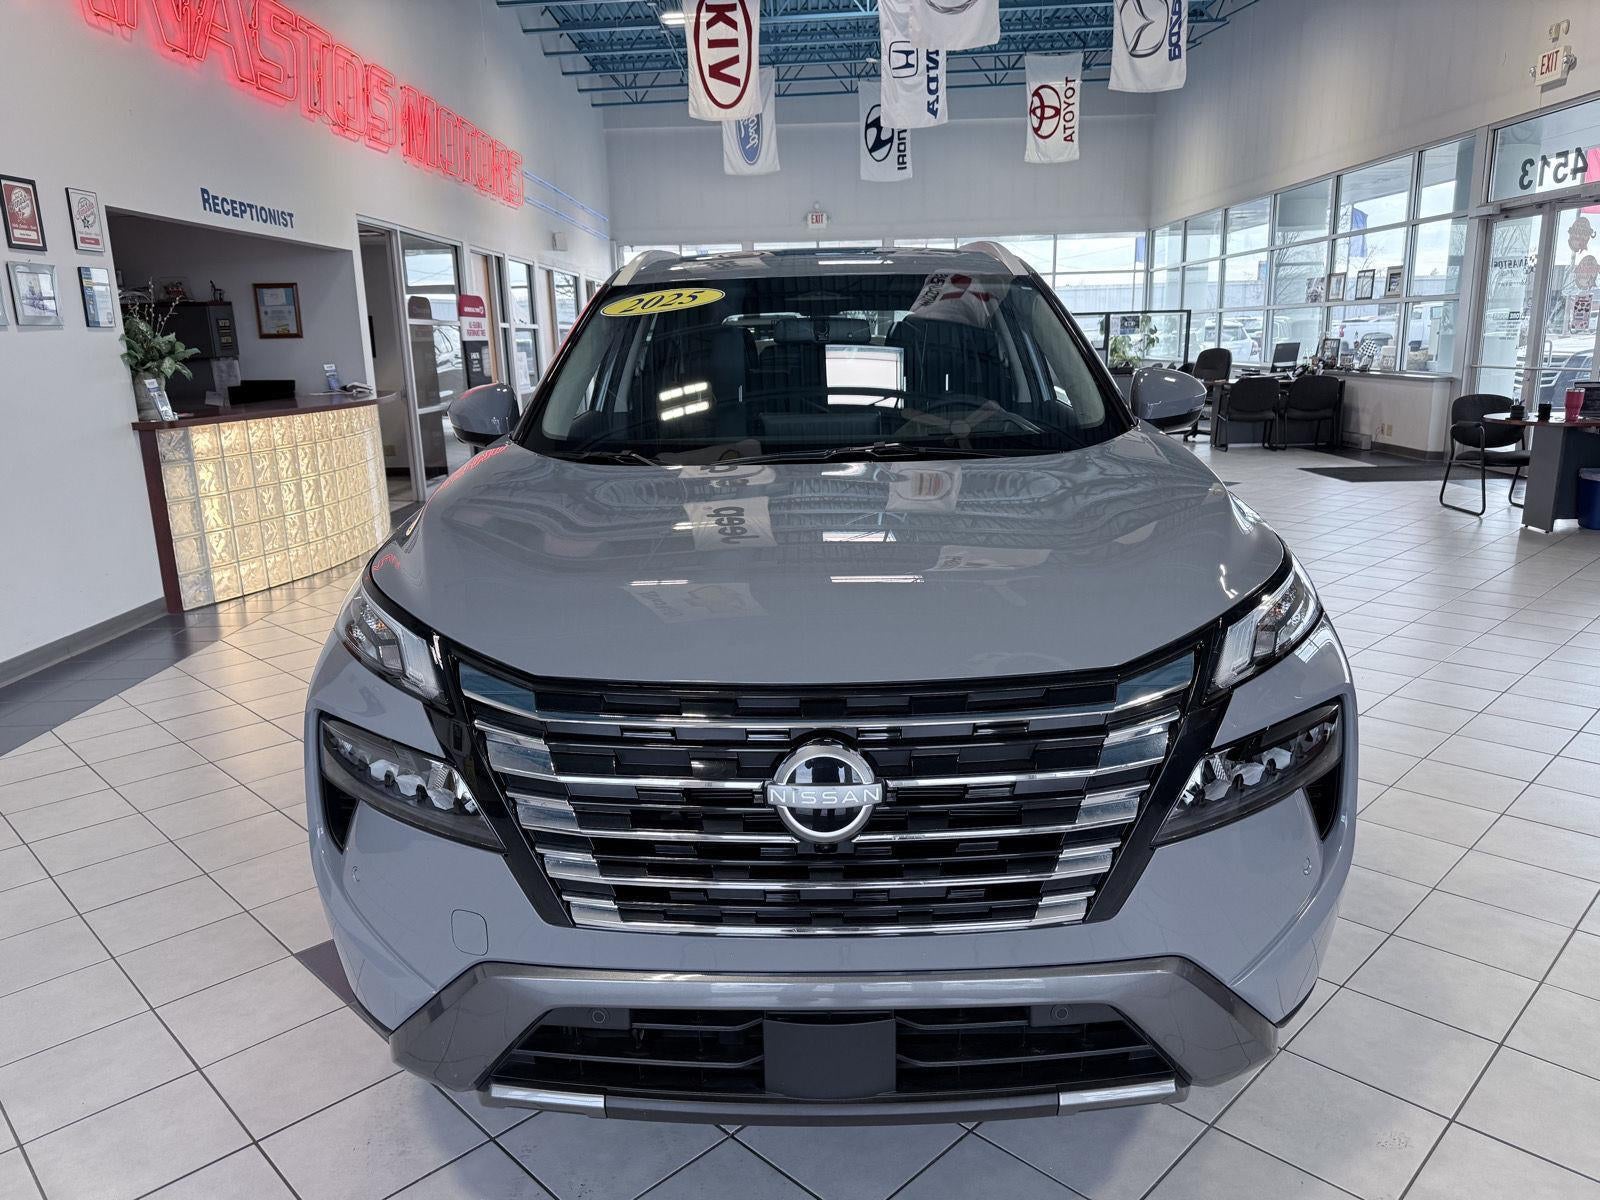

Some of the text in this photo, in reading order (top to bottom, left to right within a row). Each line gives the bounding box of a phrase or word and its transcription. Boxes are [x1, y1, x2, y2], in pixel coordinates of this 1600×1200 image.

[1540, 49, 1560, 76] EXIT
[401, 86, 524, 207] MOTORS
[811, 214, 824, 225] EXIT
[618, 291, 705, 314] 2025
[769, 787, 880, 805] NISSAN
